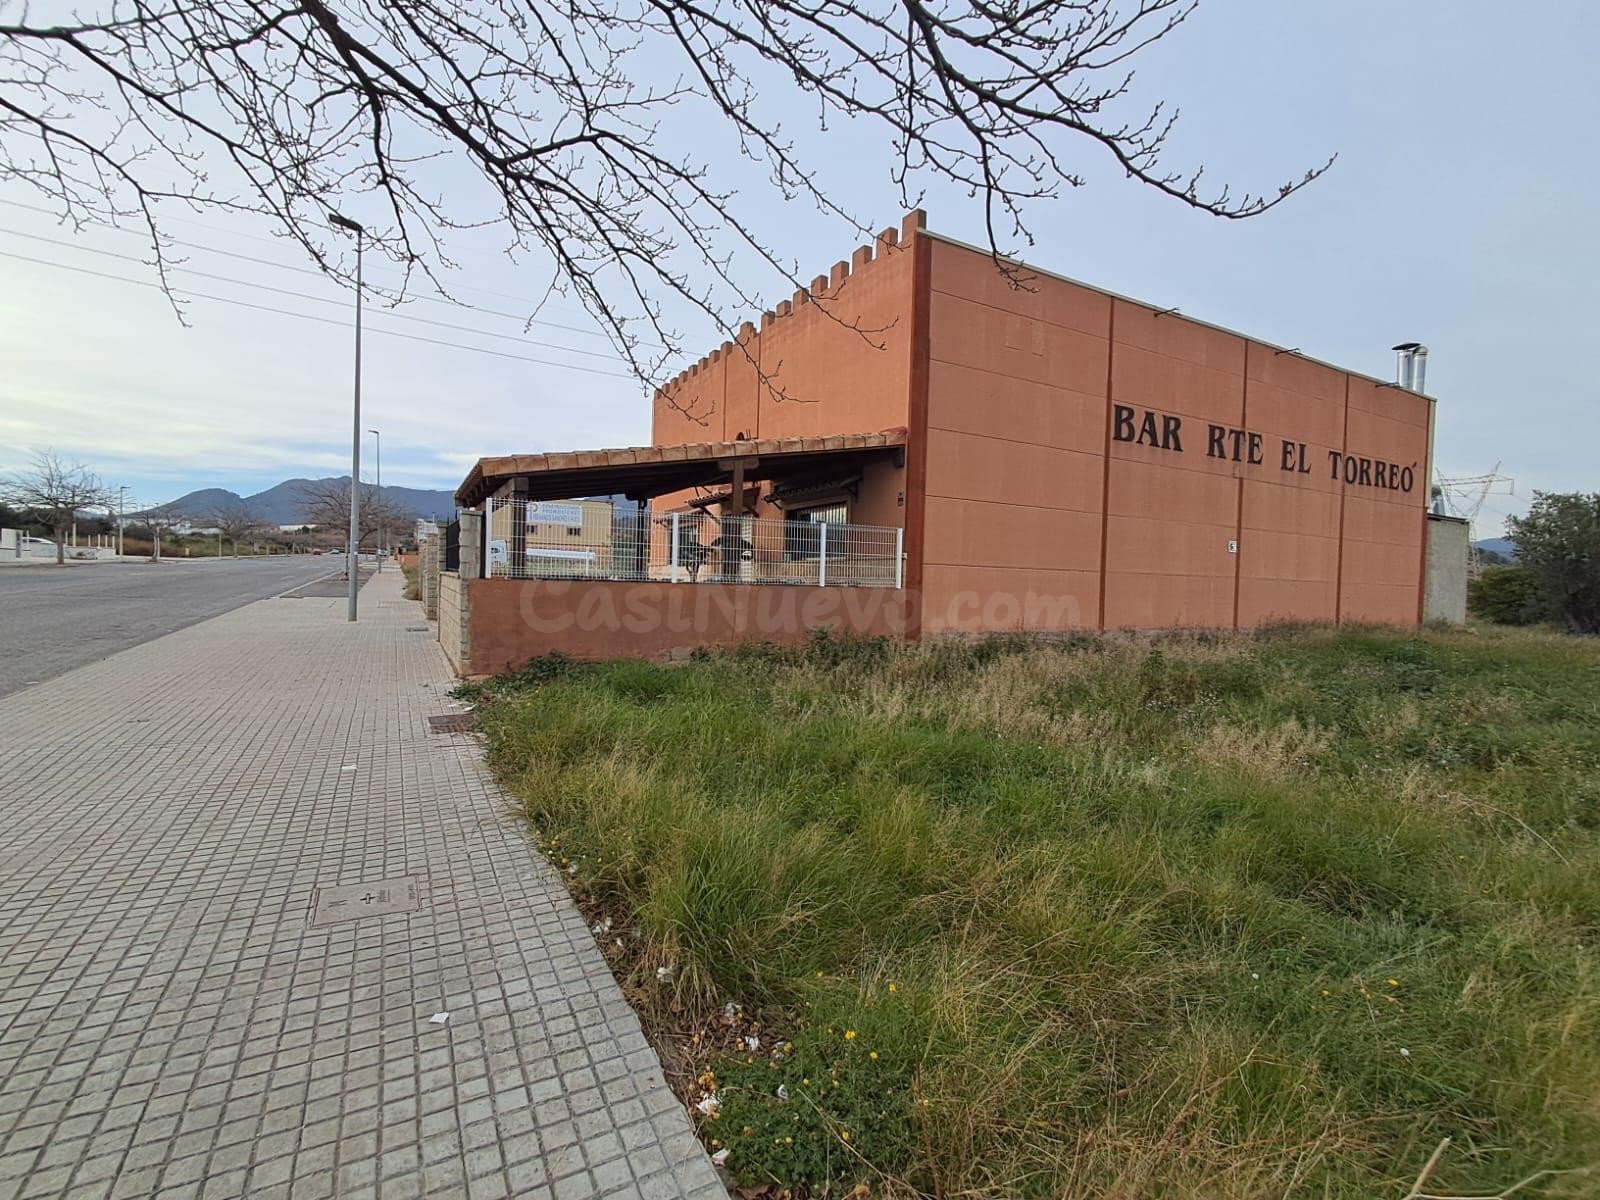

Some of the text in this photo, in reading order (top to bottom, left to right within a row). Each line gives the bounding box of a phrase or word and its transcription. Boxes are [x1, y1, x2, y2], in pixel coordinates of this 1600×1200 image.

[1113, 404, 1418, 492] BAR RTE EL TORREÓ
